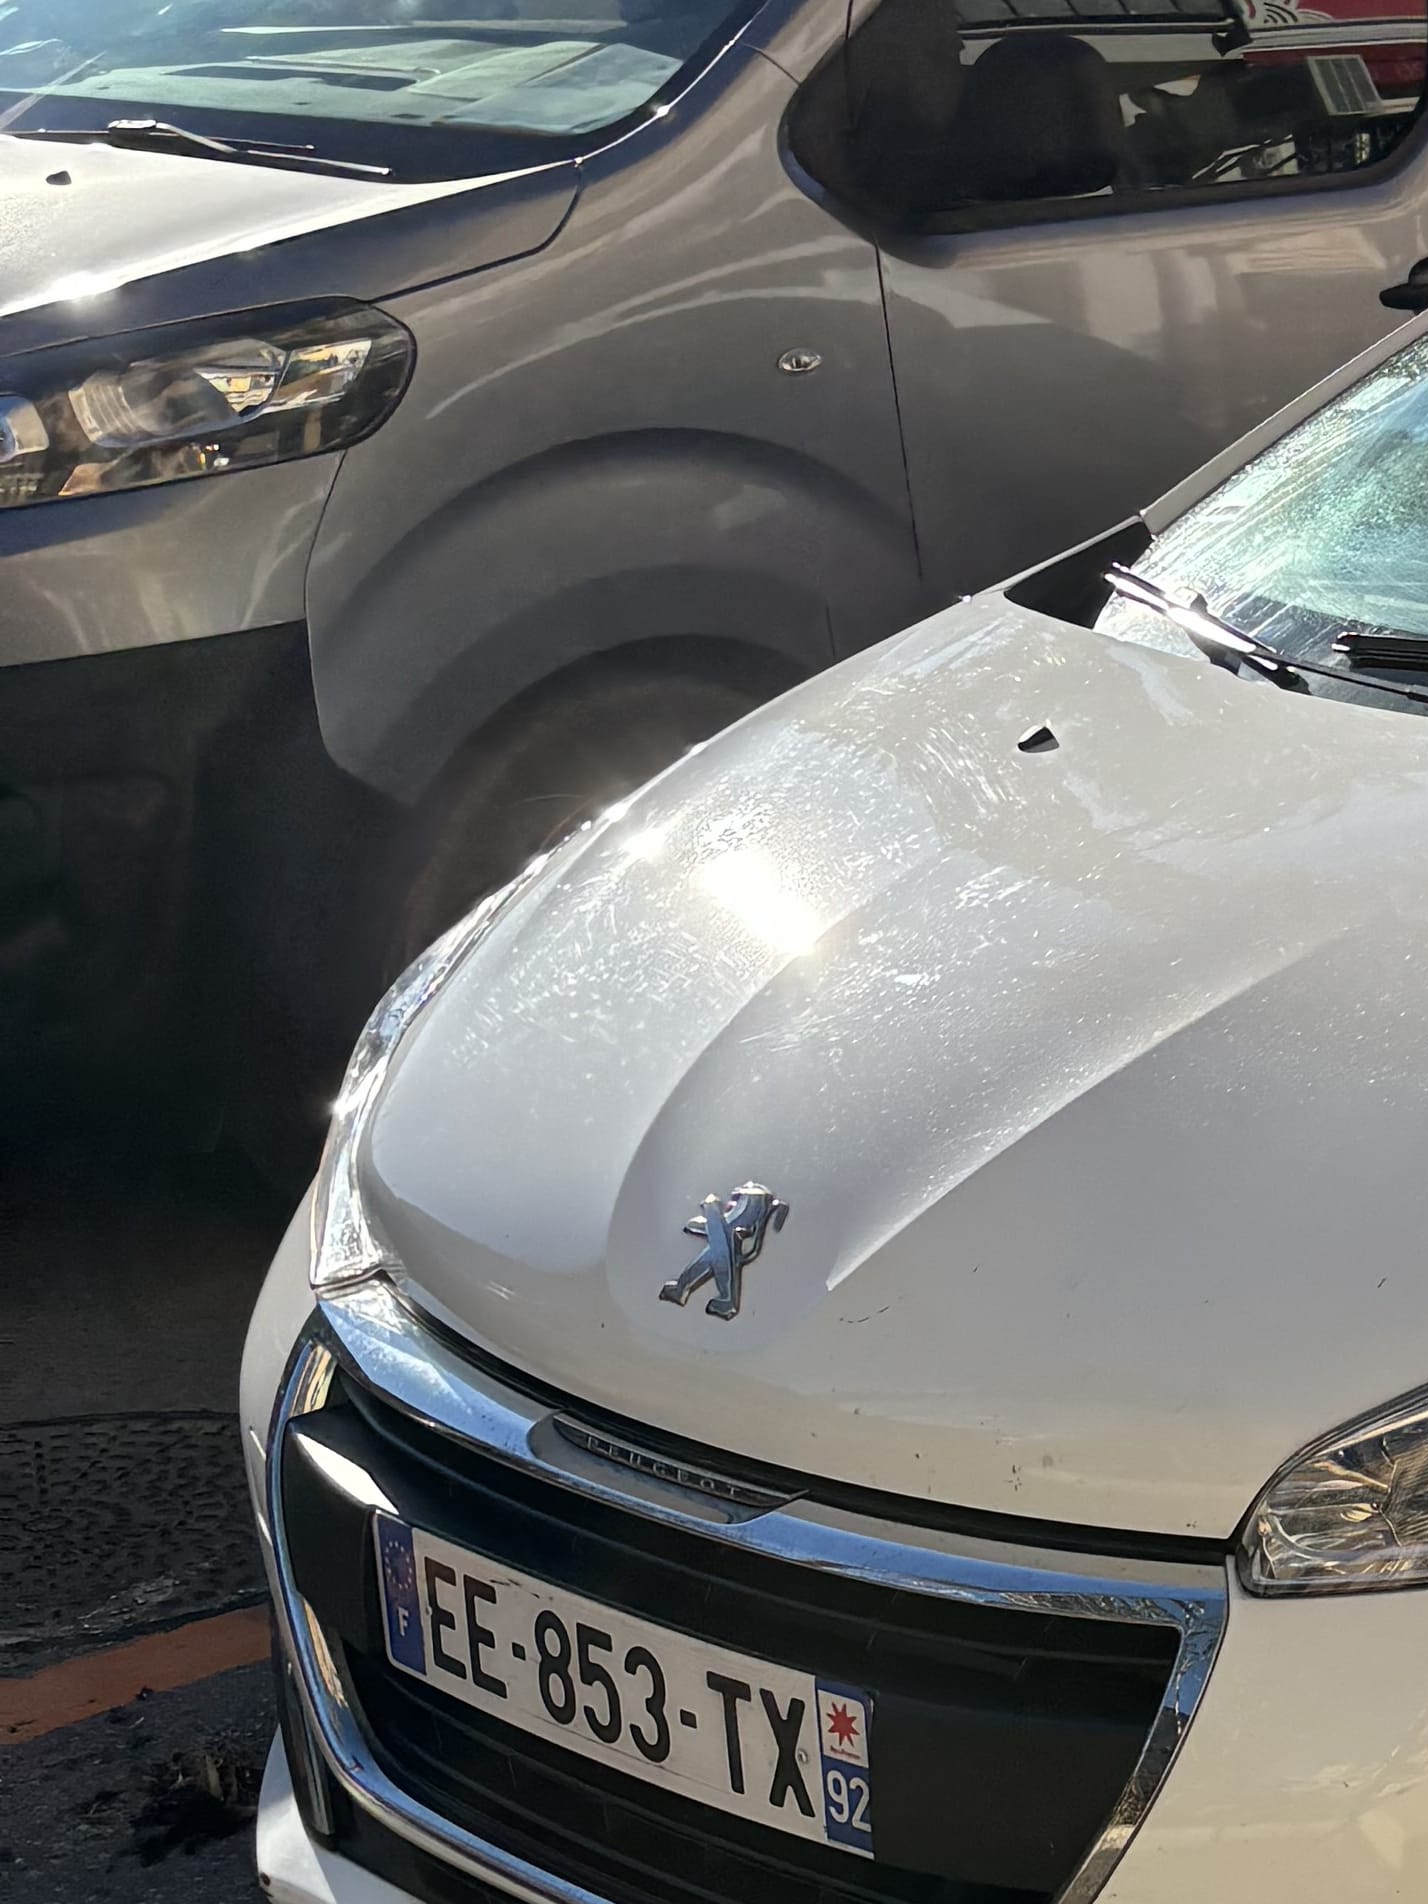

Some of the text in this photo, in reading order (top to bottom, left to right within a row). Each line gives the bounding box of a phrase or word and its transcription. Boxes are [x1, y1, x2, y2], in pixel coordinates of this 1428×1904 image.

[397, 1606, 411, 1639] F
[424, 1556, 816, 1819] EE-853-TX
[826, 1769, 872, 1833] 92
